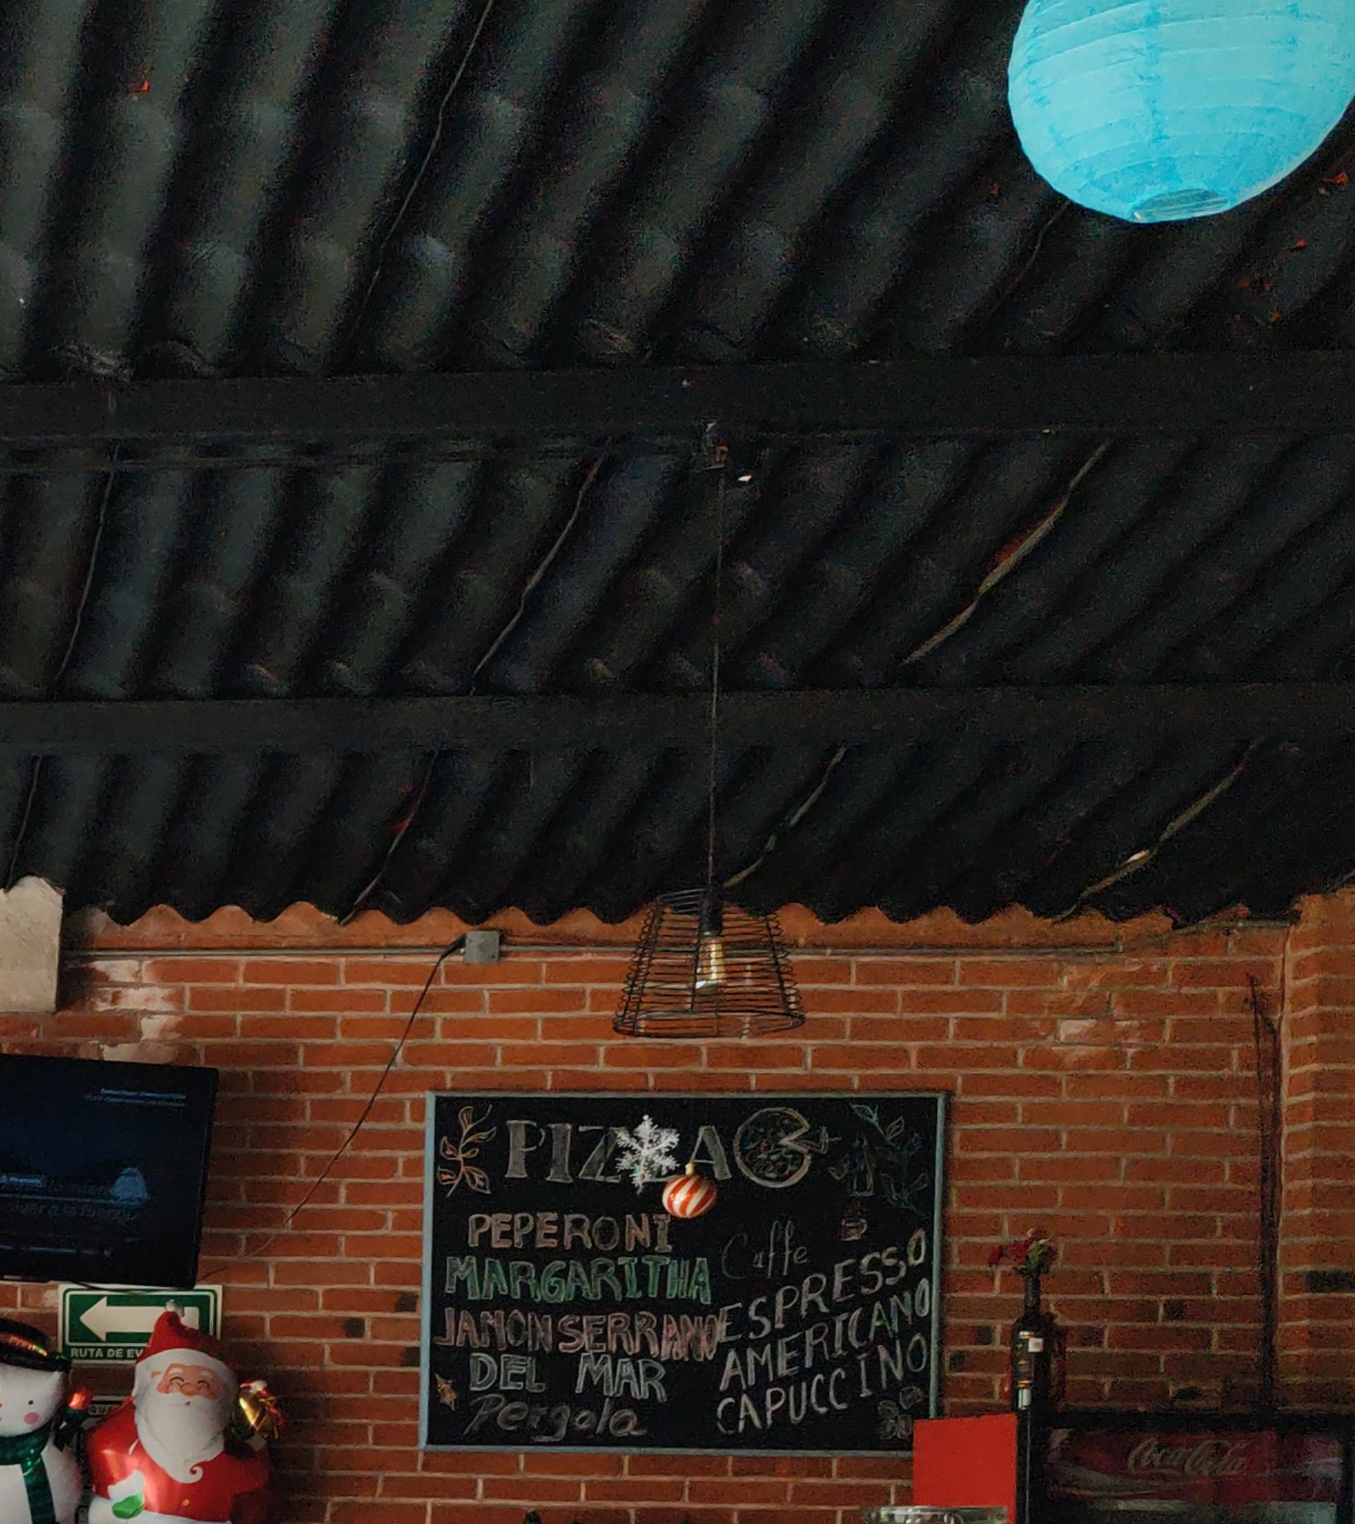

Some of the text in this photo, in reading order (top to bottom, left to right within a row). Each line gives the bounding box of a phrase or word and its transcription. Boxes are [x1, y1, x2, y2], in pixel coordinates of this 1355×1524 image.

[467, 1212, 673, 1252] PEPERONI
[444, 1255, 712, 1304] MARGARITHA
[717, 1227, 928, 1343] ESPRESSO
[70, 1347, 103, 1359] RUTA
[106, 1348, 124, 1359] DE
[558, 1310, 724, 1362] SERRANO
[719, 1278, 930, 1391] AMERICANO
[469, 1352, 668, 1402] DEL MAR
[717, 1333, 928, 1435] CAPUCCINO
